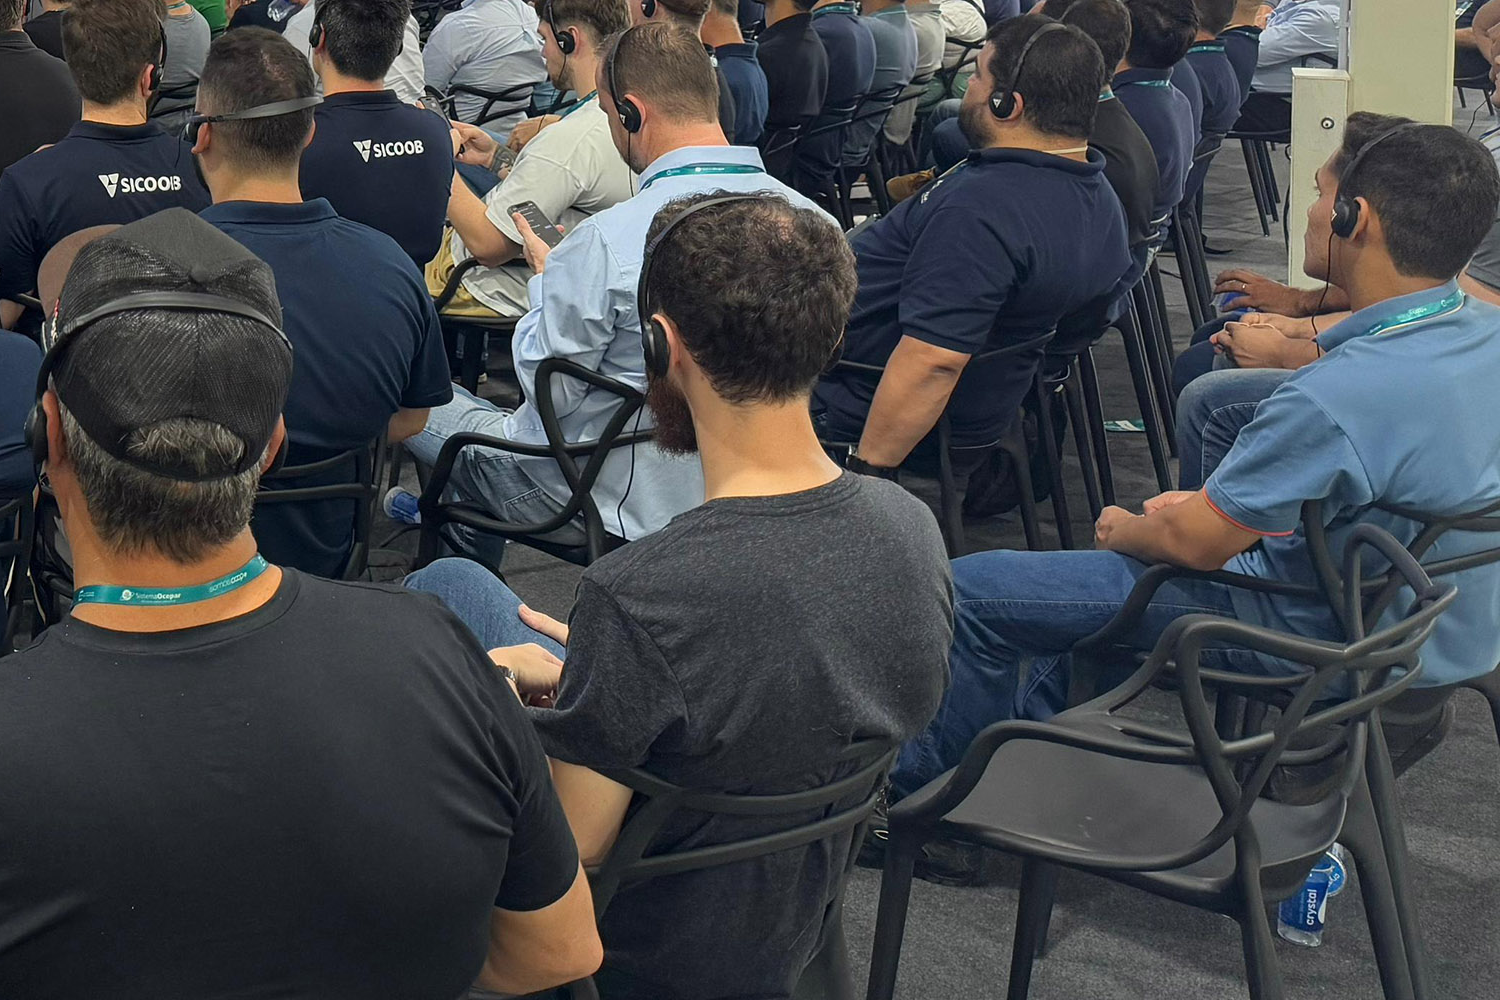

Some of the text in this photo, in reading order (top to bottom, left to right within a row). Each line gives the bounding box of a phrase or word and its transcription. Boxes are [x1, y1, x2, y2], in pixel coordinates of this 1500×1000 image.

[373, 139, 424, 158] SICOOB
[121, 175, 182, 193] SICOOB
[1306, 889, 1318, 926] crystal
